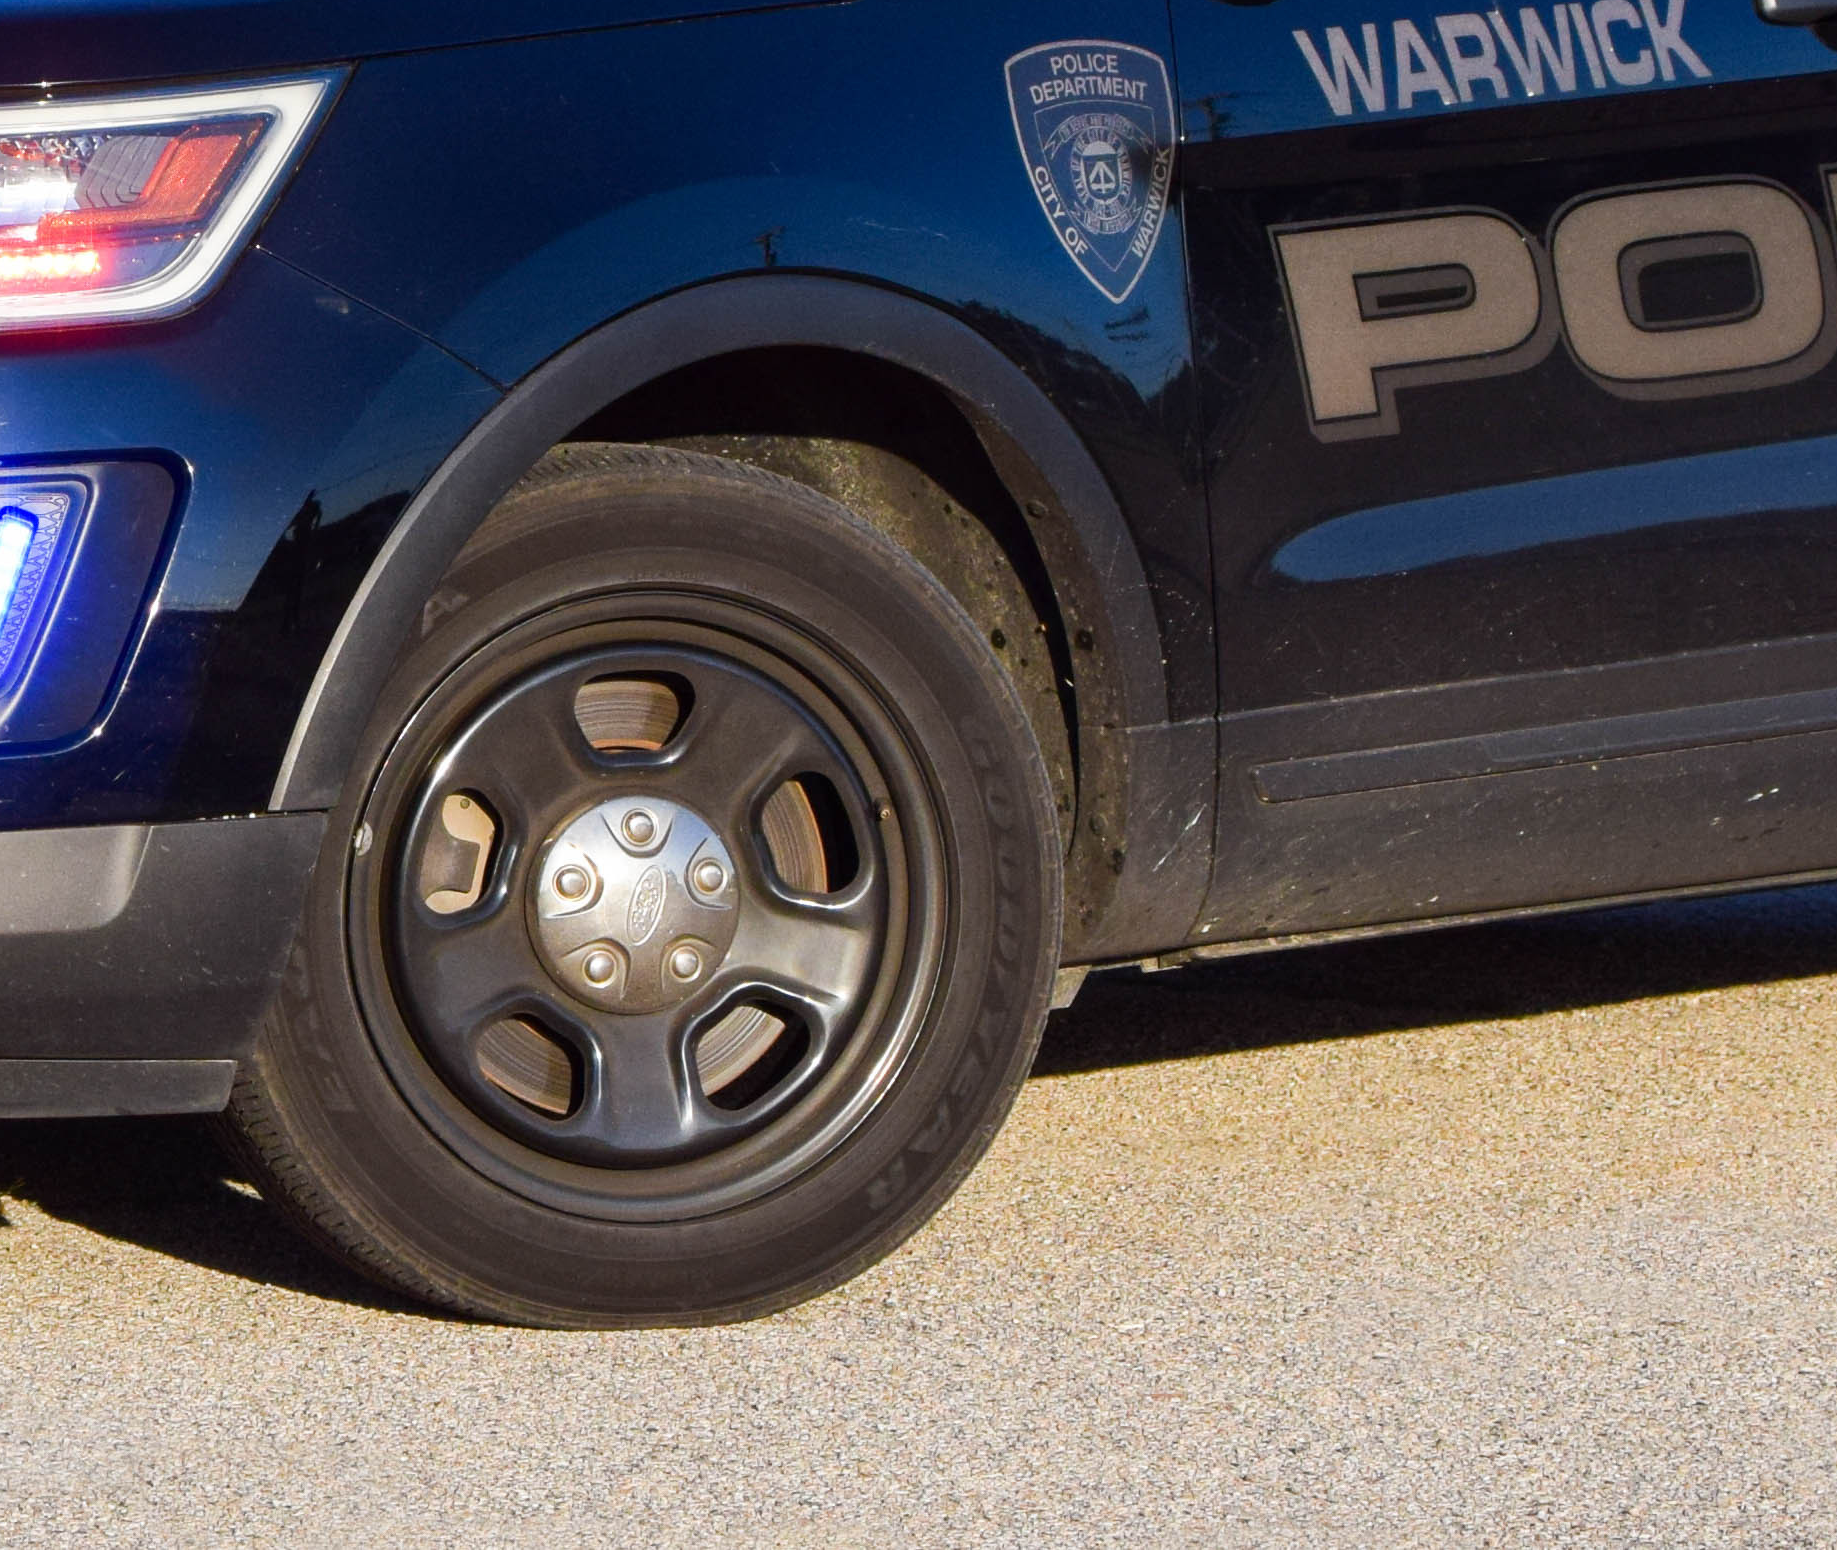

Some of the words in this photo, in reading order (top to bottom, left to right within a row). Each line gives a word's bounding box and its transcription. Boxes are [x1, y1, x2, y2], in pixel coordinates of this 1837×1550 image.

[1029, 76, 1148, 105] DEPARTMENT
[1050, 53, 1119, 75] POLICE
[1034, 165, 1066, 219] CITY
[1065, 226, 1089, 256] OF
[1131, 147, 1171, 259] WARWICK
